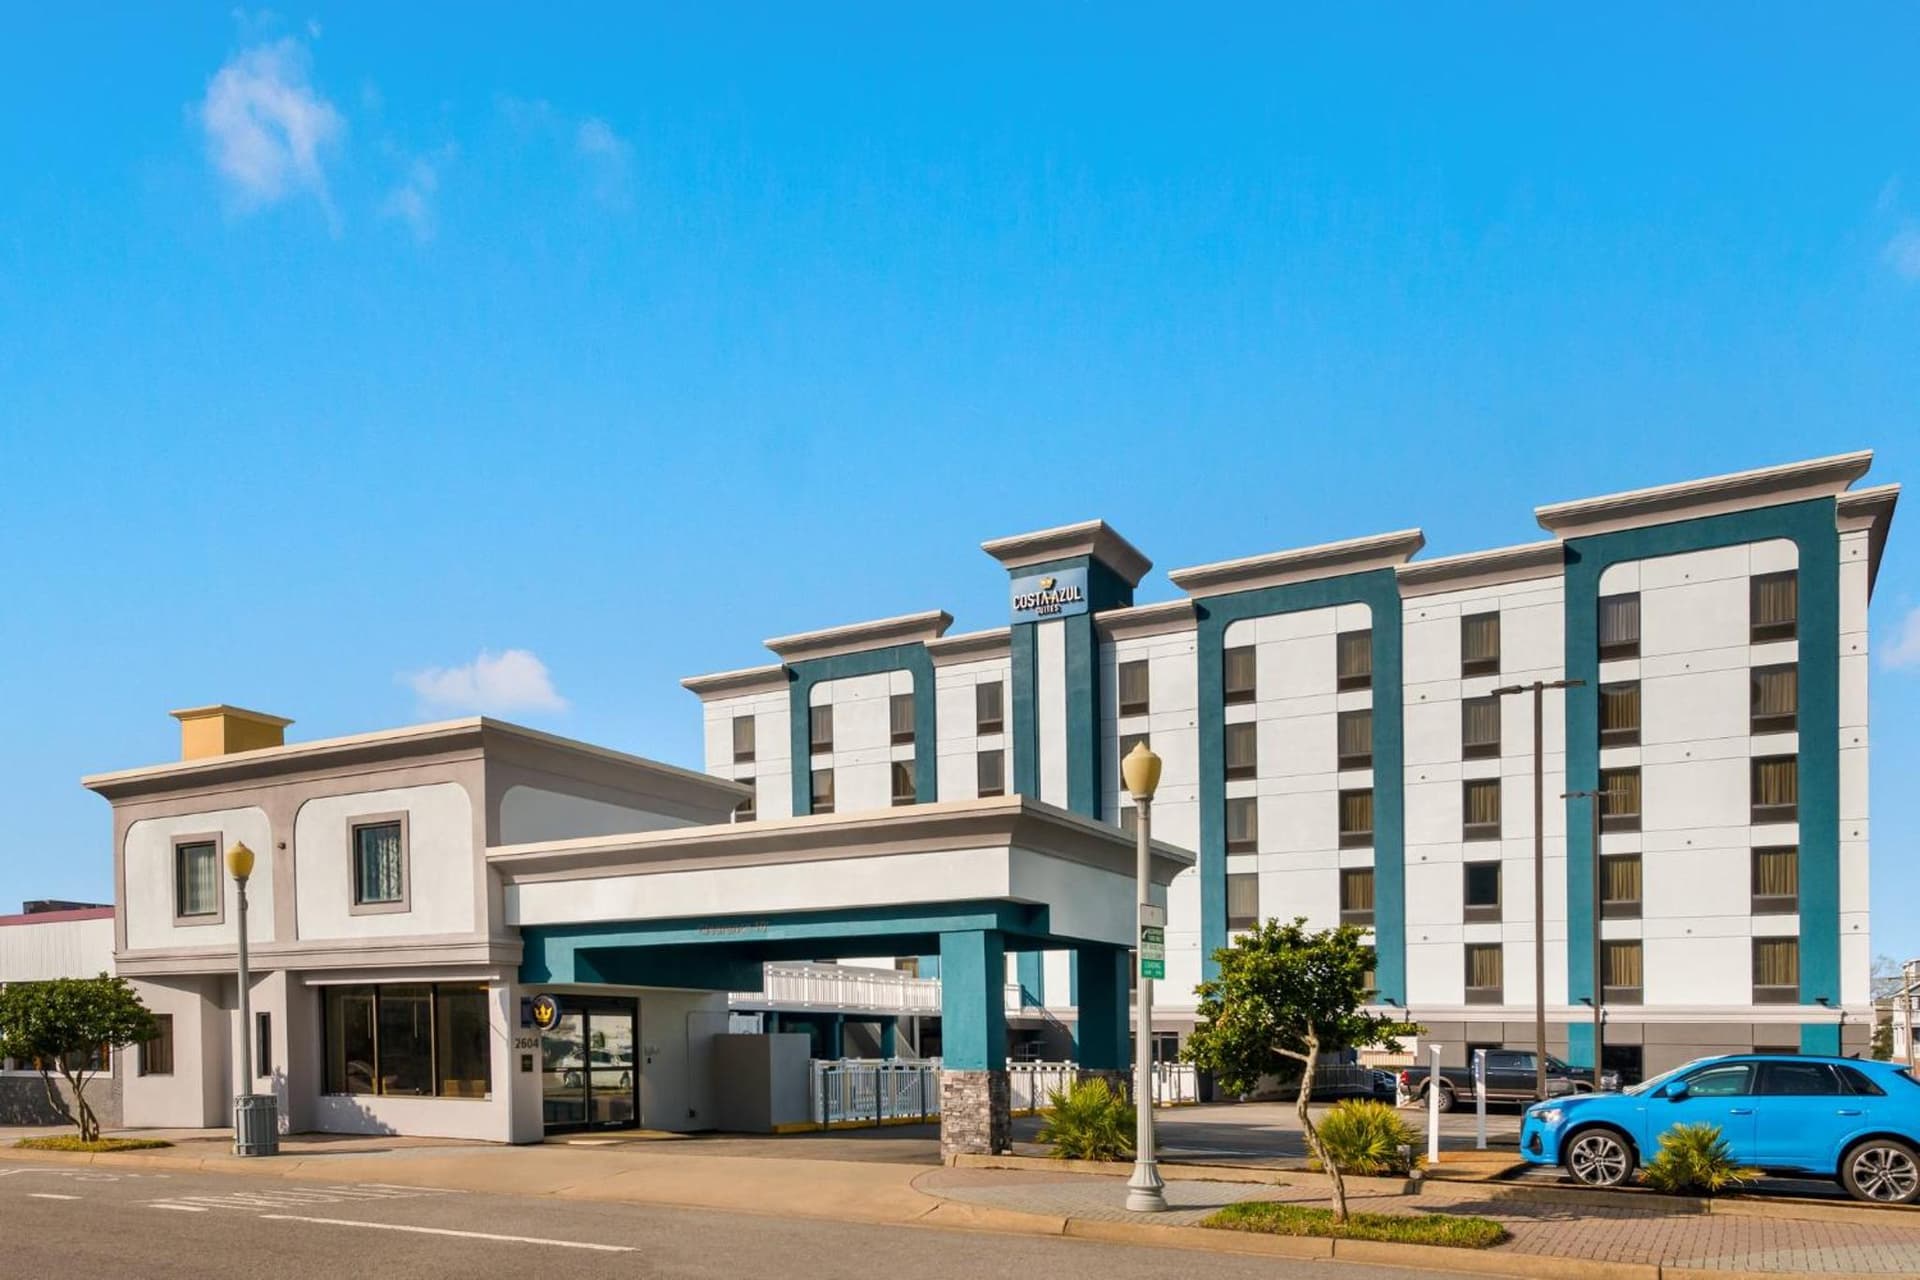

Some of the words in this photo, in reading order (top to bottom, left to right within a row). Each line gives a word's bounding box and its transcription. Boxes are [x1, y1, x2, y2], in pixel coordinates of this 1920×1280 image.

[1013, 590, 1049, 609] COSTA
[1051, 585, 1082, 603] AZUL
[514, 1037, 540, 1049] 2604
